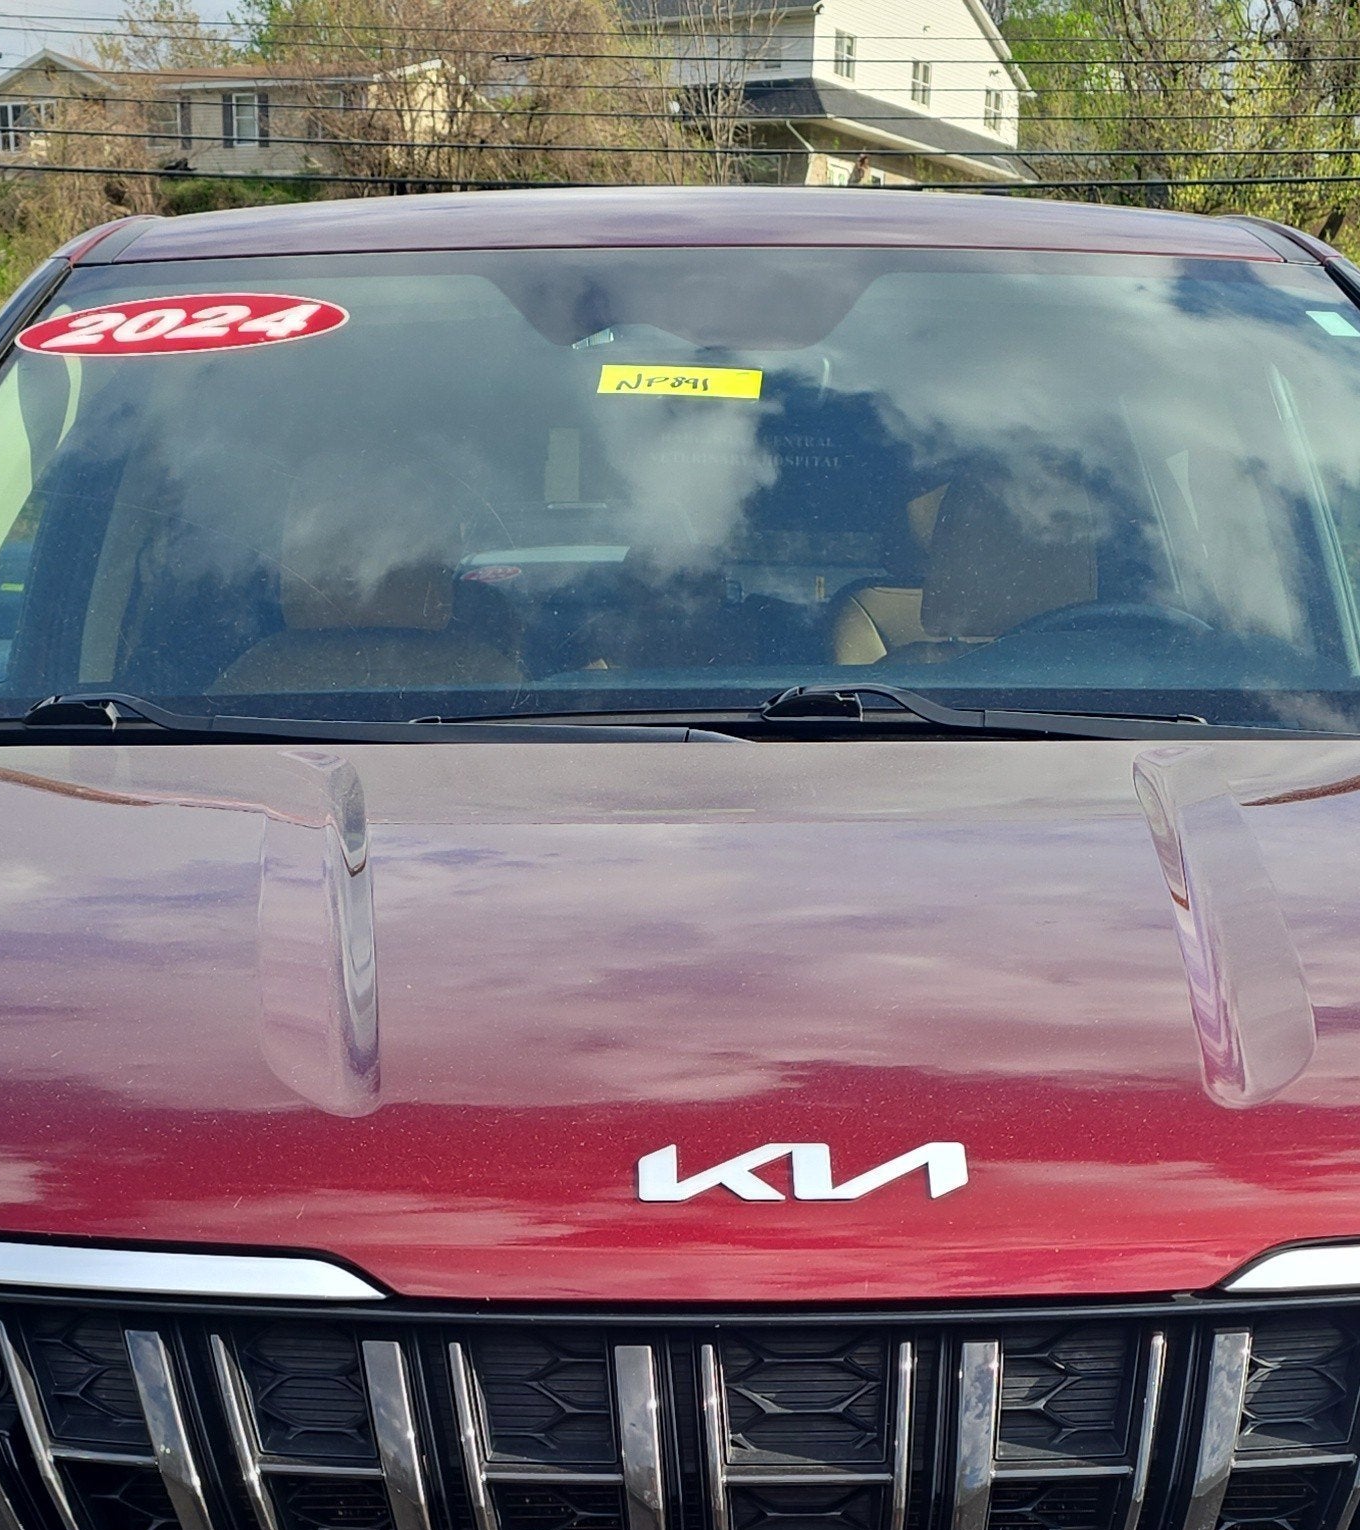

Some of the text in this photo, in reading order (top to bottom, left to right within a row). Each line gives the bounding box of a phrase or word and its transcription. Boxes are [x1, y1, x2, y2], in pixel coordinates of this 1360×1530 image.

[40, 304, 322, 348] 2024
[615, 373, 709, 391] NP891
[637, 1141, 970, 1203] KIA
